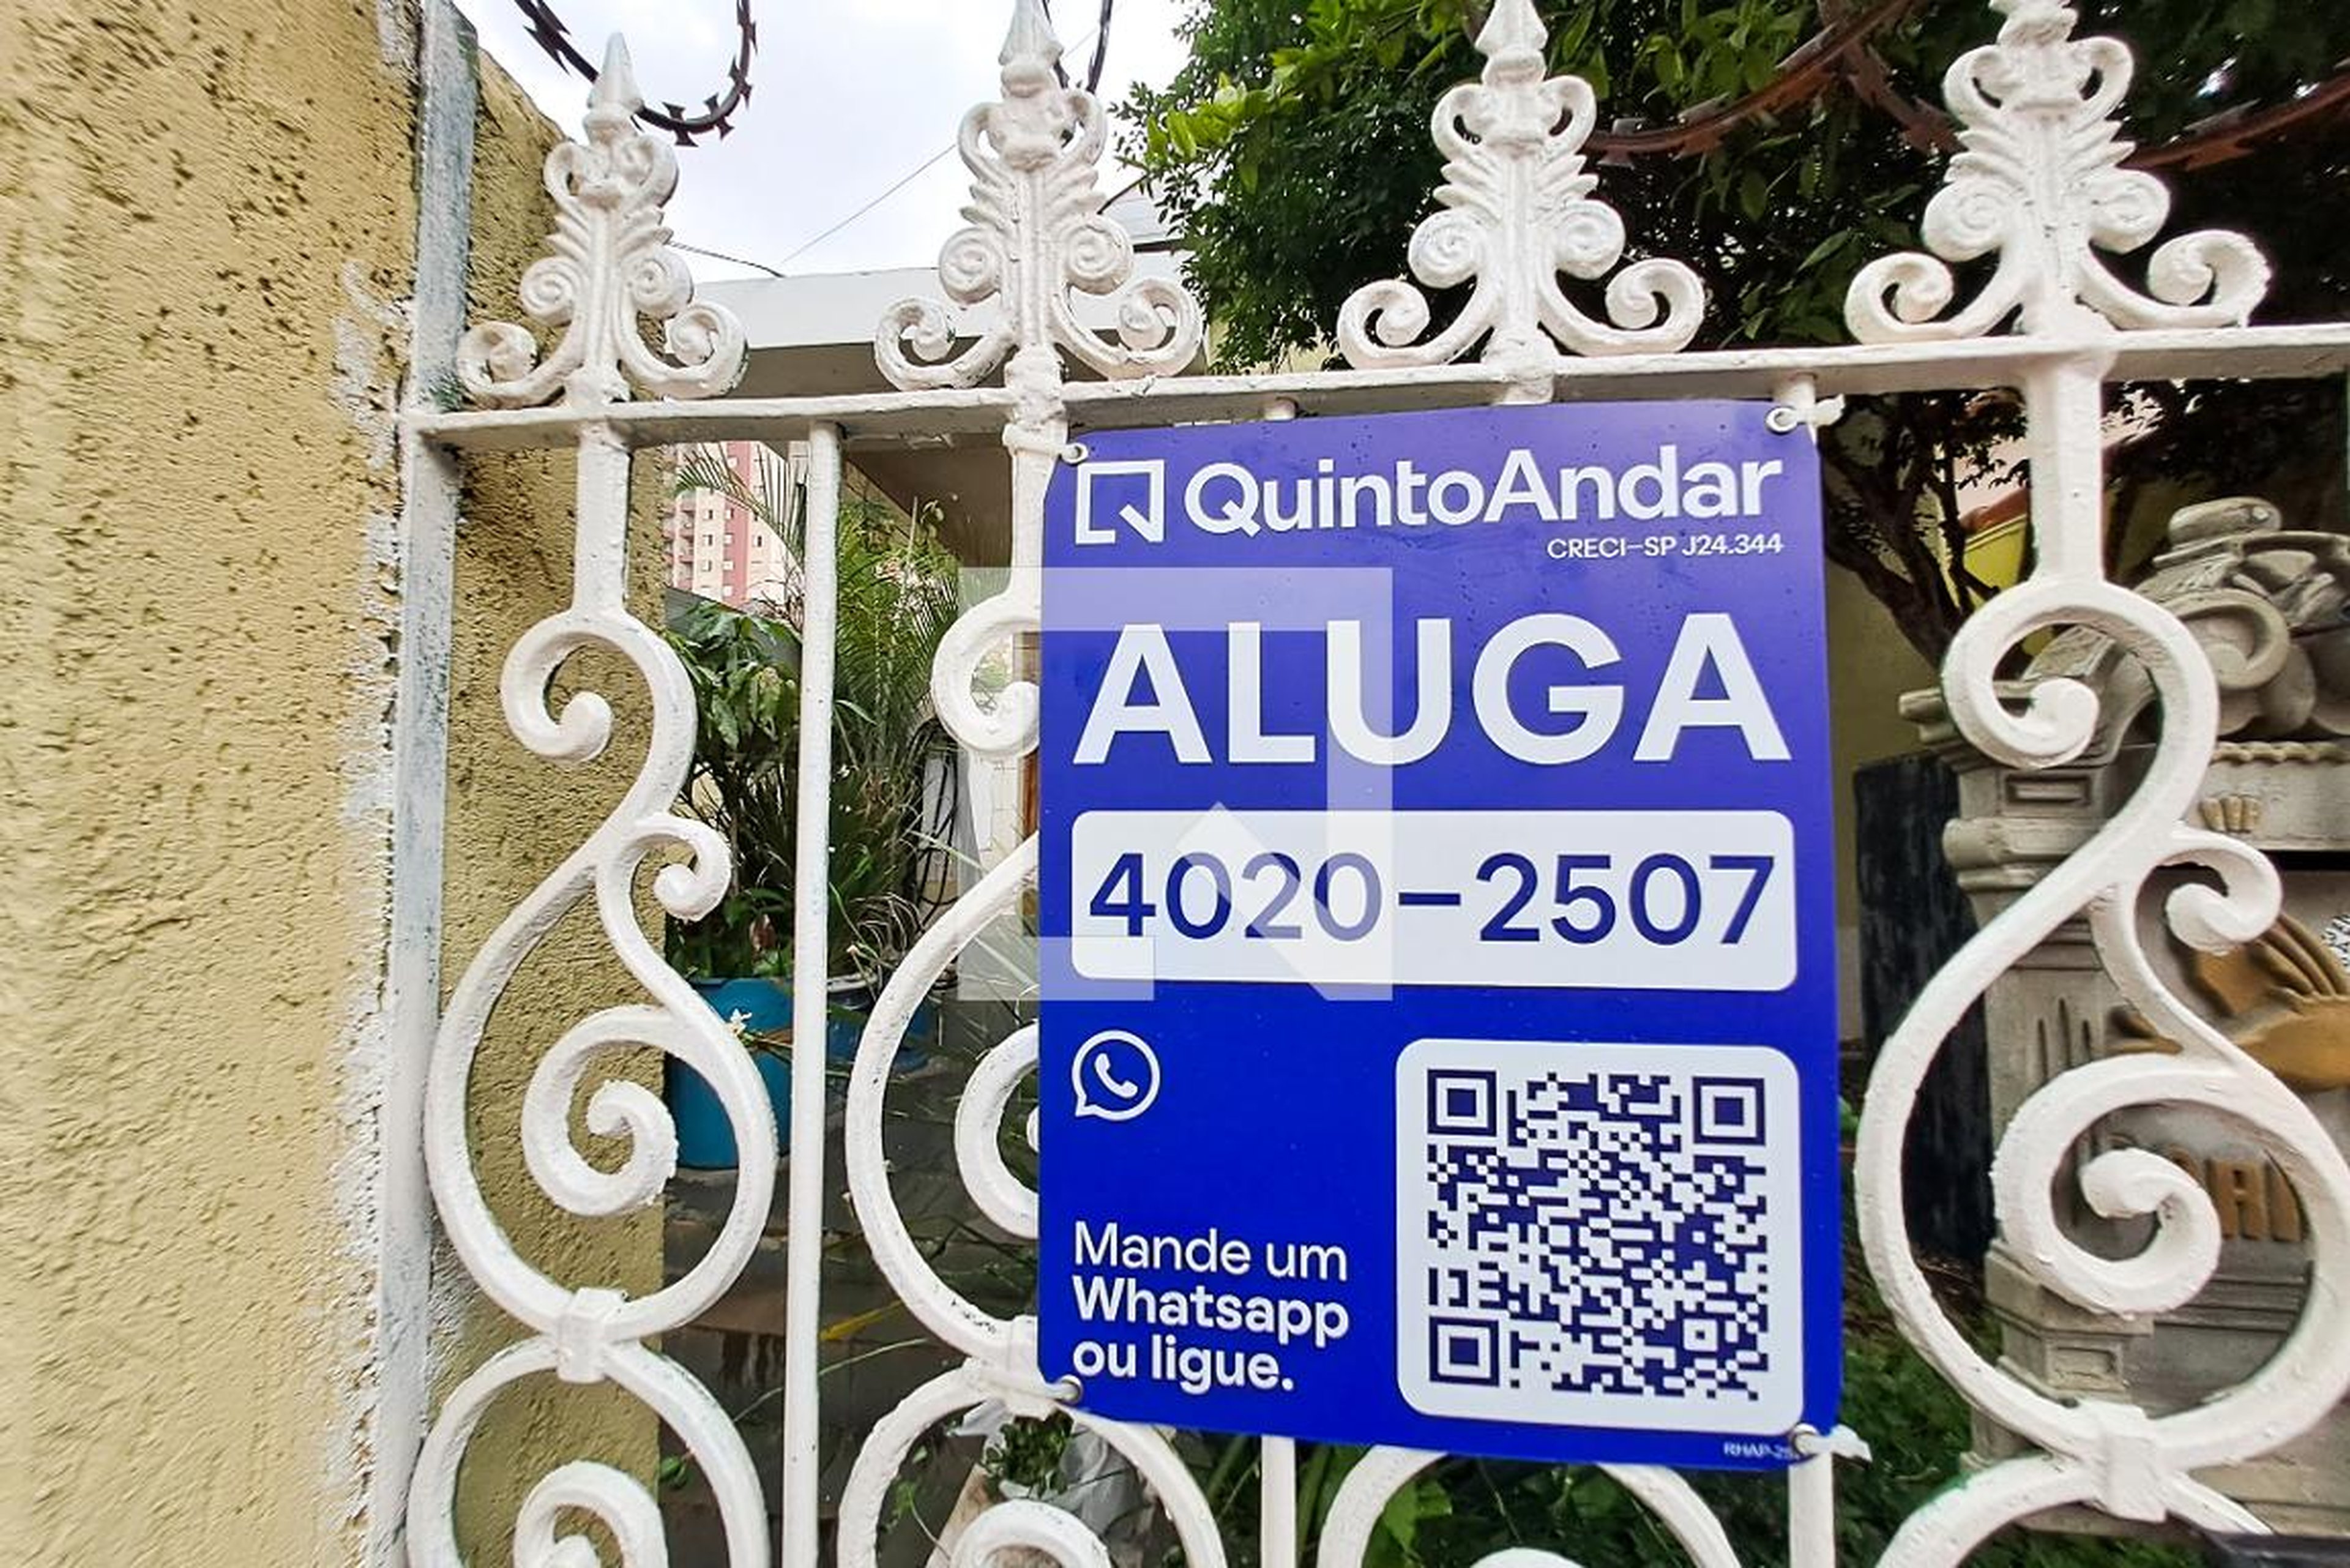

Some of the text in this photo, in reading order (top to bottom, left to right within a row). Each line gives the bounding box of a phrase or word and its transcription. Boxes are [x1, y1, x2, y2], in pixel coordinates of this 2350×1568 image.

[1185, 445, 1782, 537] QuintoAndar
[1547, 532, 1785, 559] CRECI-SP J24.344
[1073, 613, 1791, 765] ALUGA
[1089, 851, 1775, 946] 4020-2507
[1075, 1220, 1348, 1282] Mande um
[1072, 1274, 1349, 1348] Whatsapp
[1073, 1334, 1294, 1395] ou ligue.
